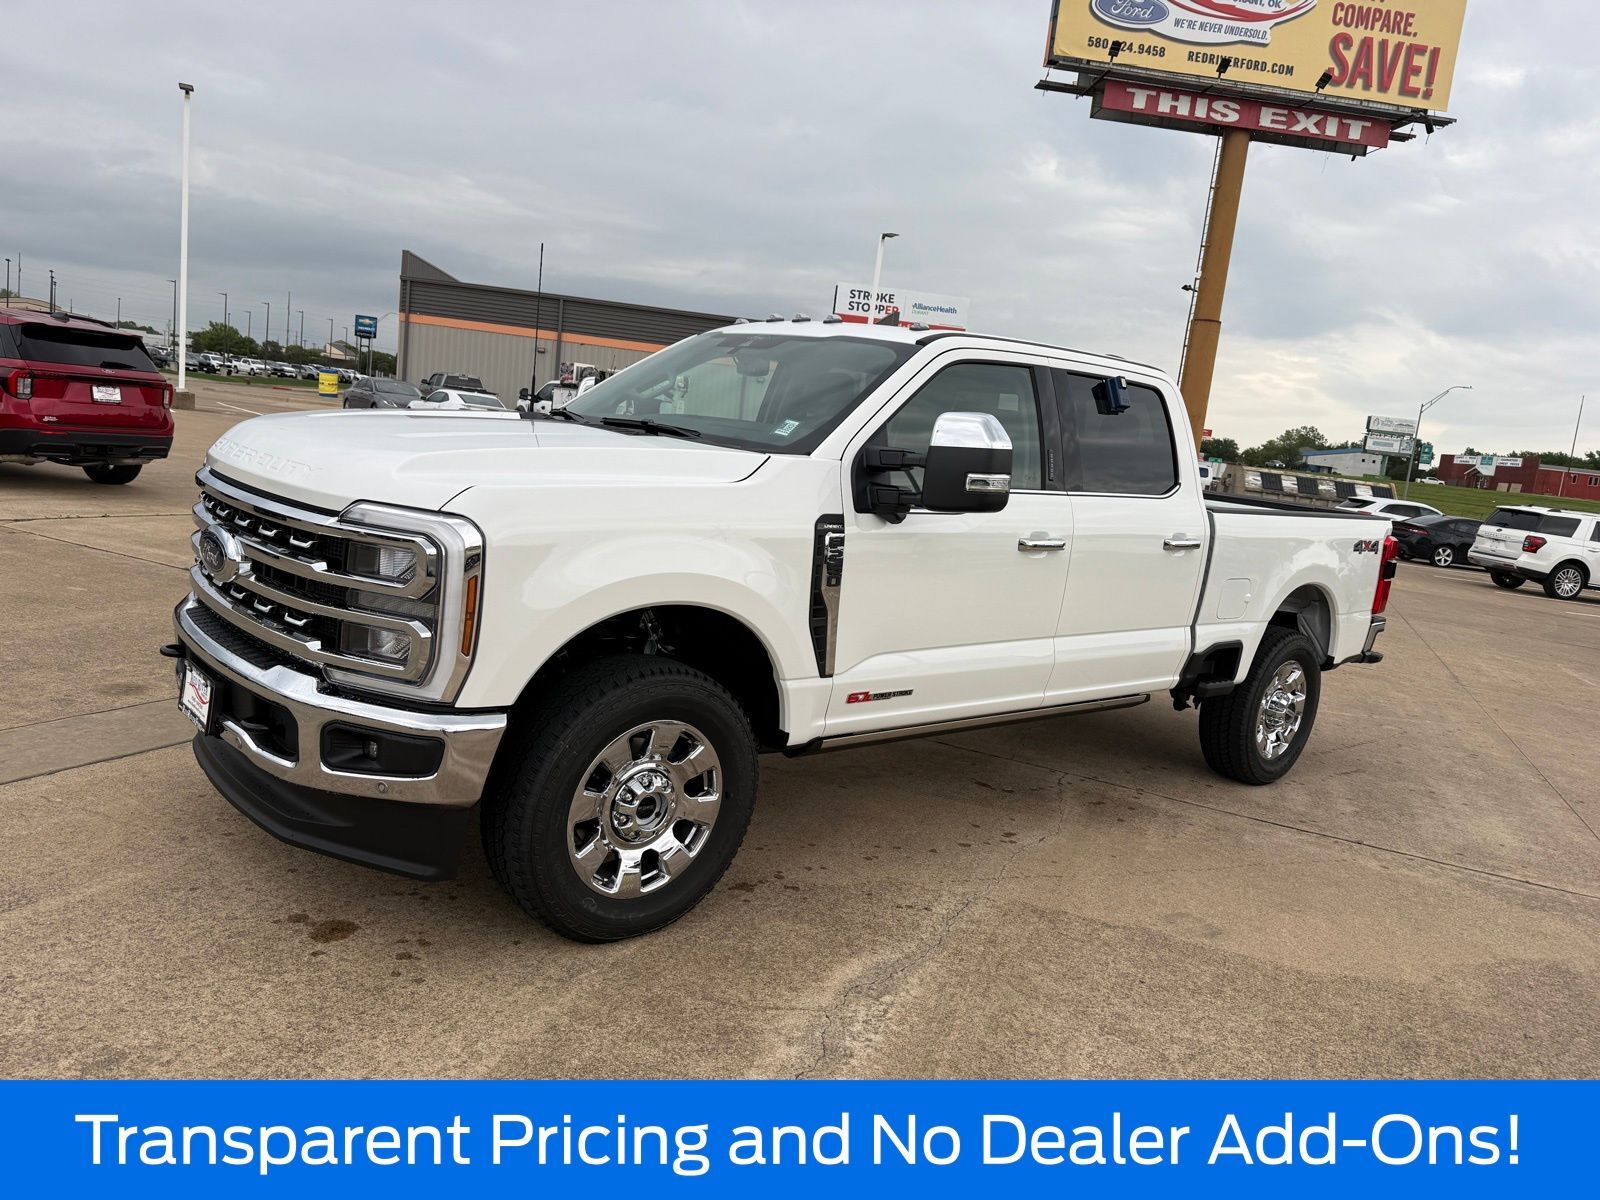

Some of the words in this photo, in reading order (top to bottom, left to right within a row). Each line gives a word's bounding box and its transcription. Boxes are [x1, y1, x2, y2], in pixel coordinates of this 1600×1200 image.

[1111, 0, 1154, 18] Ford
[1268, 0, 1281, 8] OK
[1174, 18, 1198, 30] WE'RE
[1198, 21, 1223, 34] NEVER
[1224, 25, 1268, 40] UNDERSOLD.
[1332, 2, 1418, 37] COMPARE.
[1087, 36, 1166, 57] 58024.9458
[1327, 32, 1441, 99] SAVE!
[1126, 87, 1241, 123] THIS
[1259, 106, 1372, 140] EXIT
[912, 302, 957, 314] AllianceHealth
